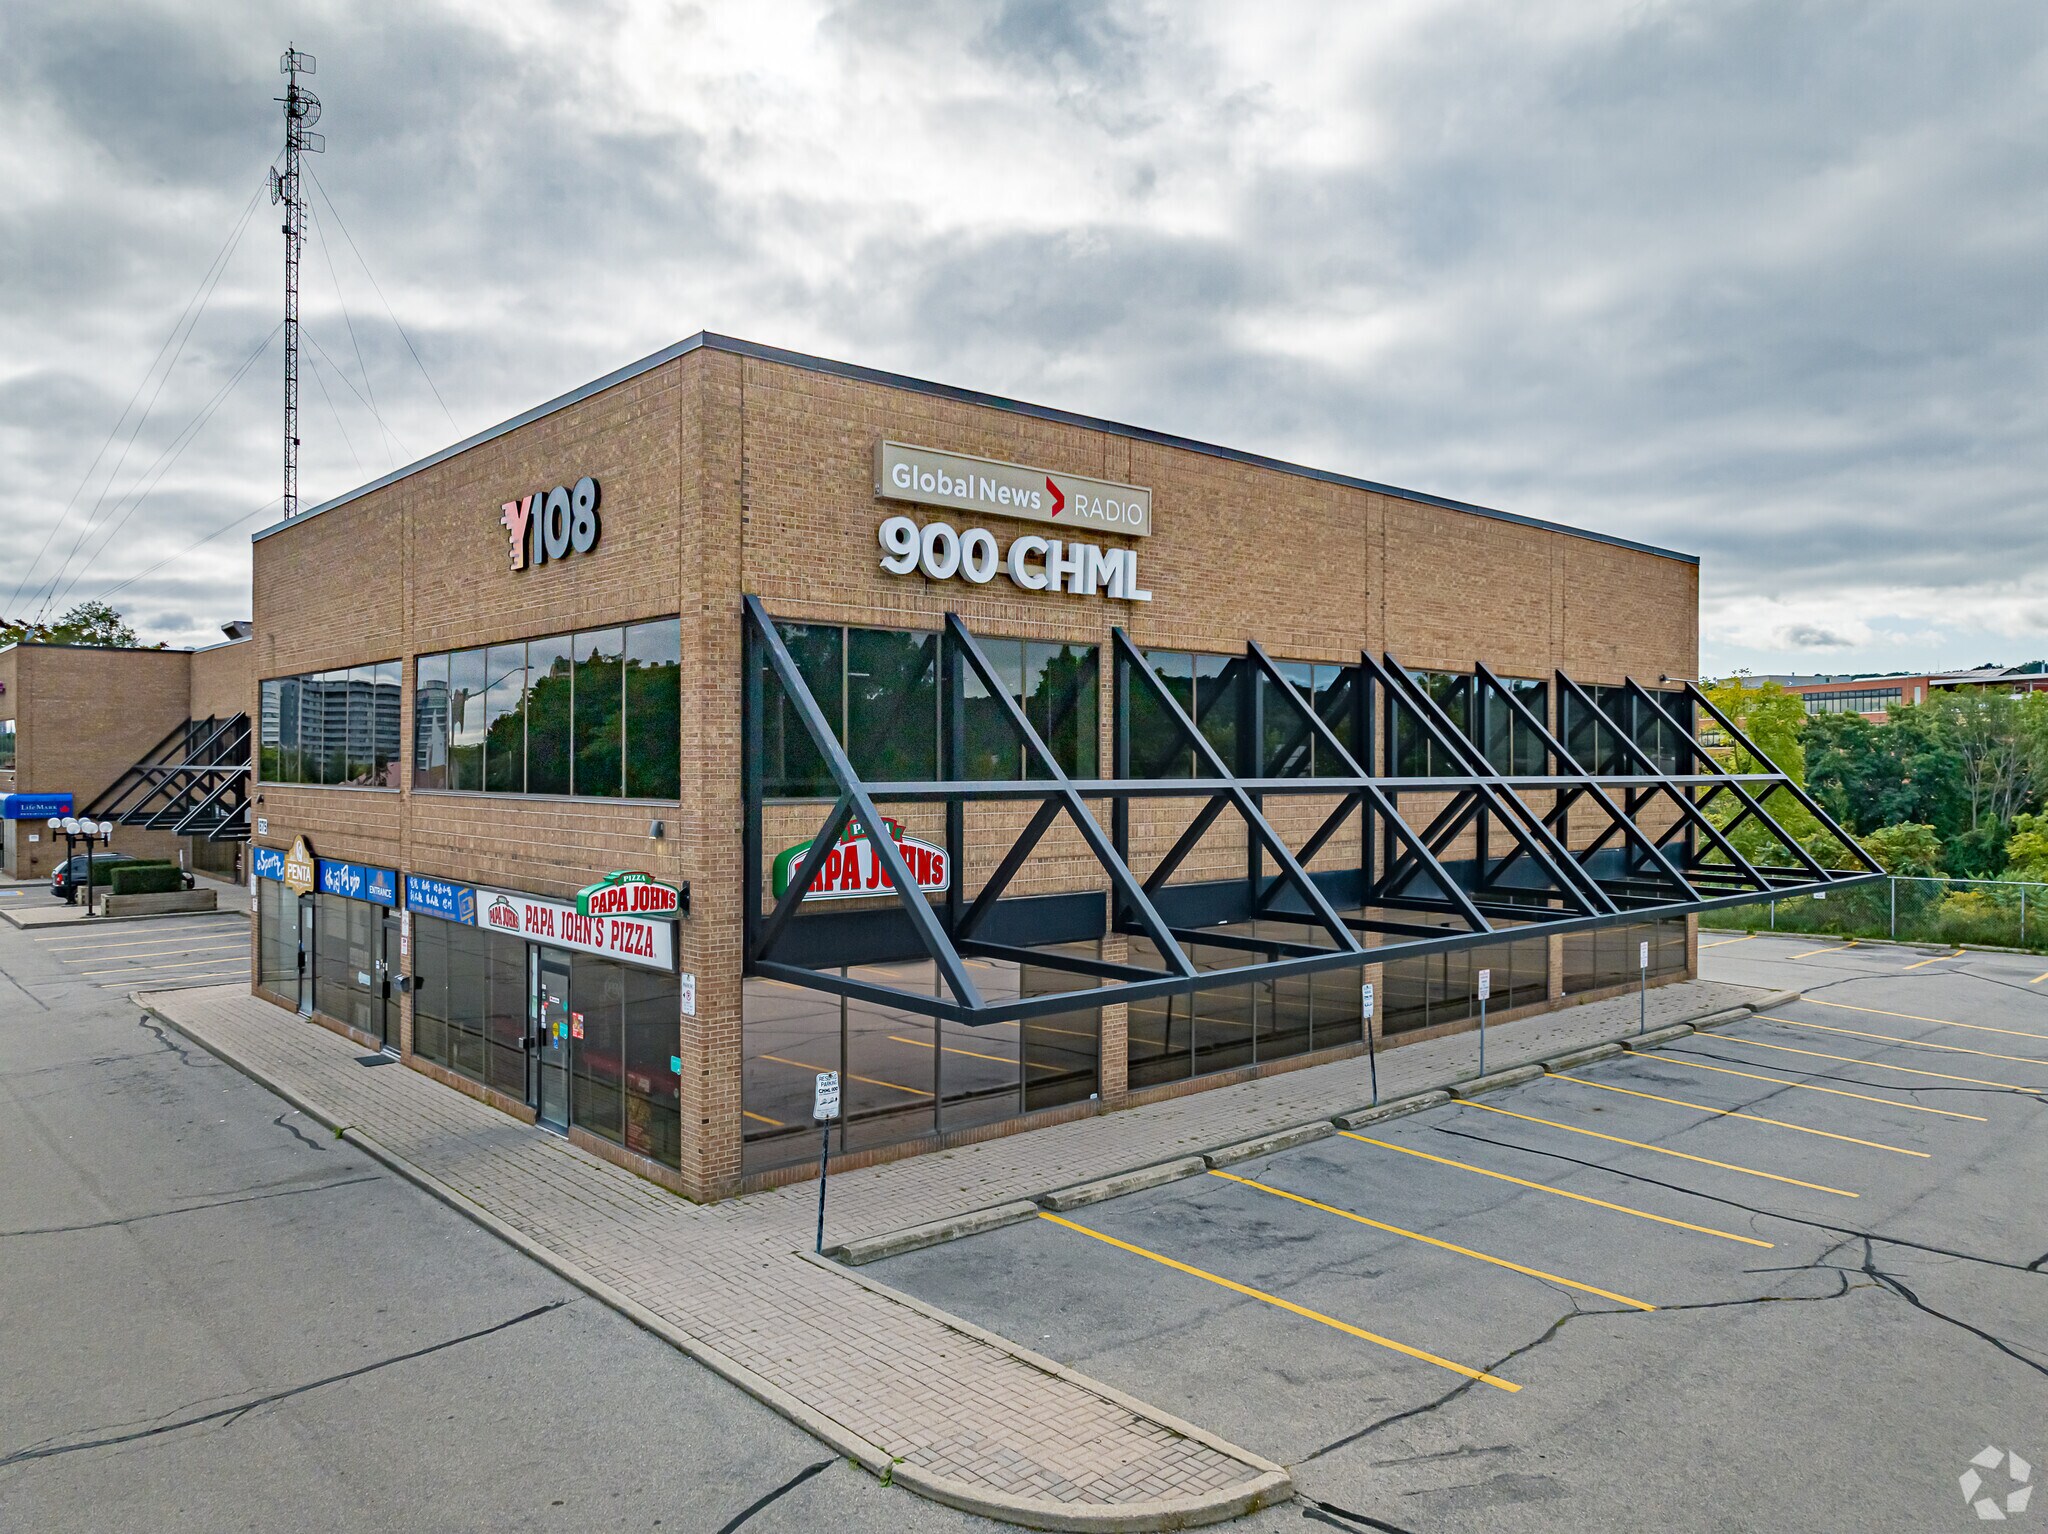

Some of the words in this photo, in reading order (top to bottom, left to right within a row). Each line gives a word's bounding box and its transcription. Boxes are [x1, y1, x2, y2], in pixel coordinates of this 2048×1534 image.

[891, 462, 974, 499] Global
[979, 477, 1041, 510] News
[1075, 494, 1143, 526] RADIO
[500, 475, 602, 571] Y108
[878, 516, 999, 584] 900
[1007, 535, 1153, 602] CHML
[287, 862, 312, 883] PENTA
[623, 873, 646, 883] PIZZA
[369, 885, 392, 899] ENTRANCE
[591, 887, 628, 914] PAPA
[630, 885, 677, 912] JOHN'S
[489, 906, 503, 926] PAPA
[525, 904, 555, 938] PAPA
[560, 911, 604, 948] JOHN'S
[610, 920, 654, 958] PIZZA
